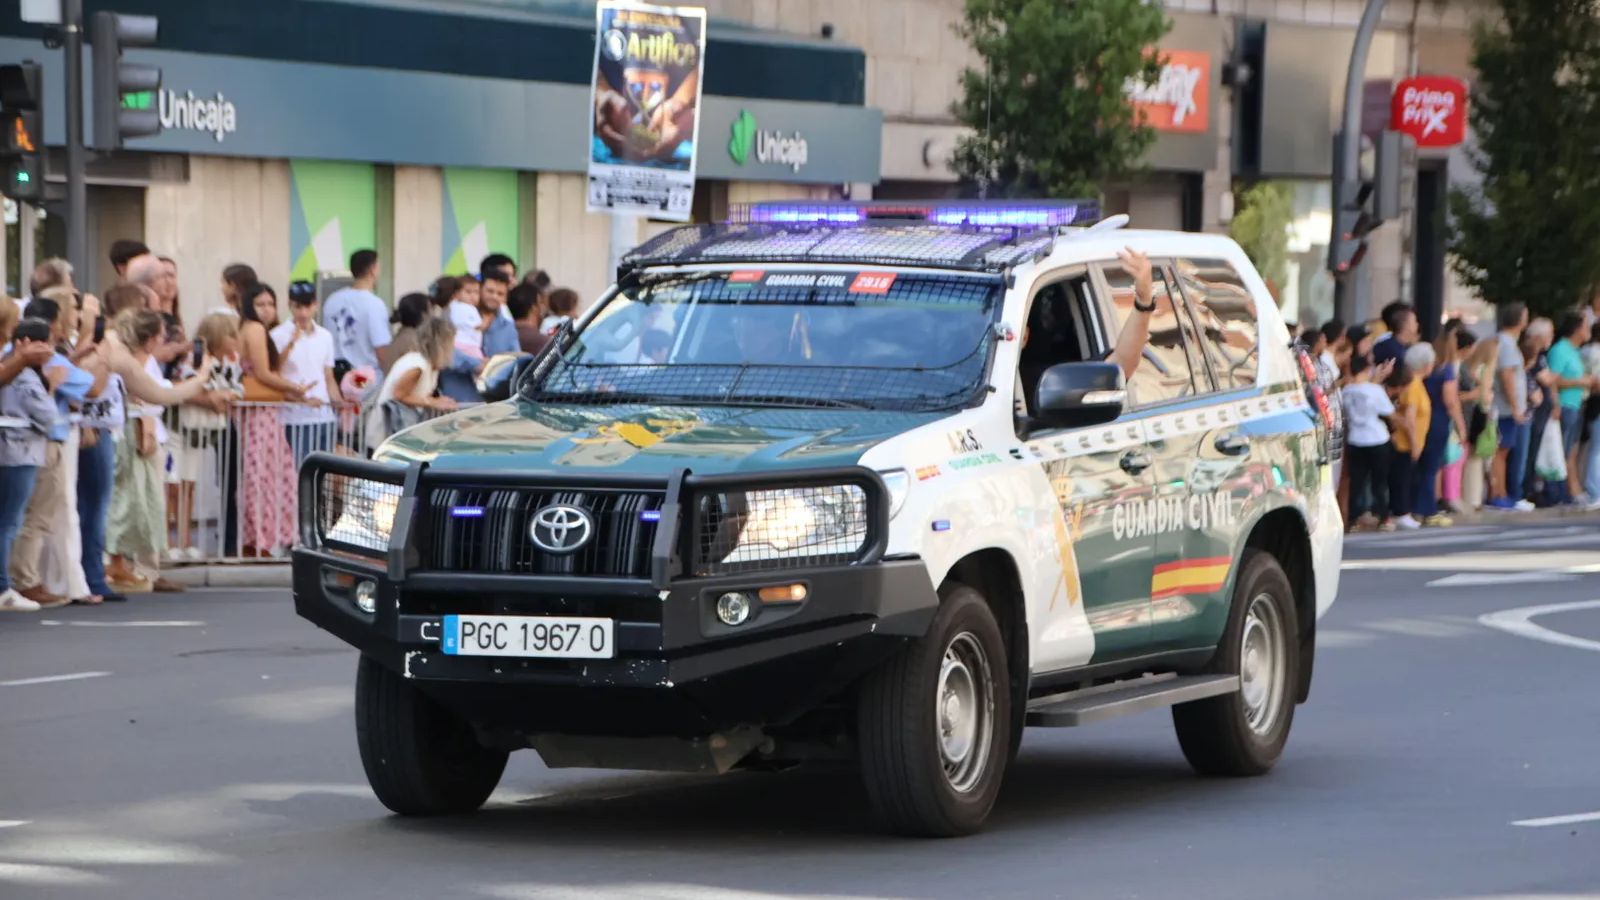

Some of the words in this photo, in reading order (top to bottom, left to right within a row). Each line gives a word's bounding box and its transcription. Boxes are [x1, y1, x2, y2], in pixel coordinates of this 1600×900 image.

[158, 88, 236, 143] Unicaja
[1402, 86, 1455, 107] Prima
[756, 129, 807, 173] Unicaja
[765, 273, 816, 288] GUARDIA
[816, 274, 846, 287] CIVIL
[1111, 498, 1183, 541] GUARDIA
[1188, 490, 1234, 530] CIVIL
[460, 620, 508, 651] PGC
[520, 622, 581, 653] 1967
